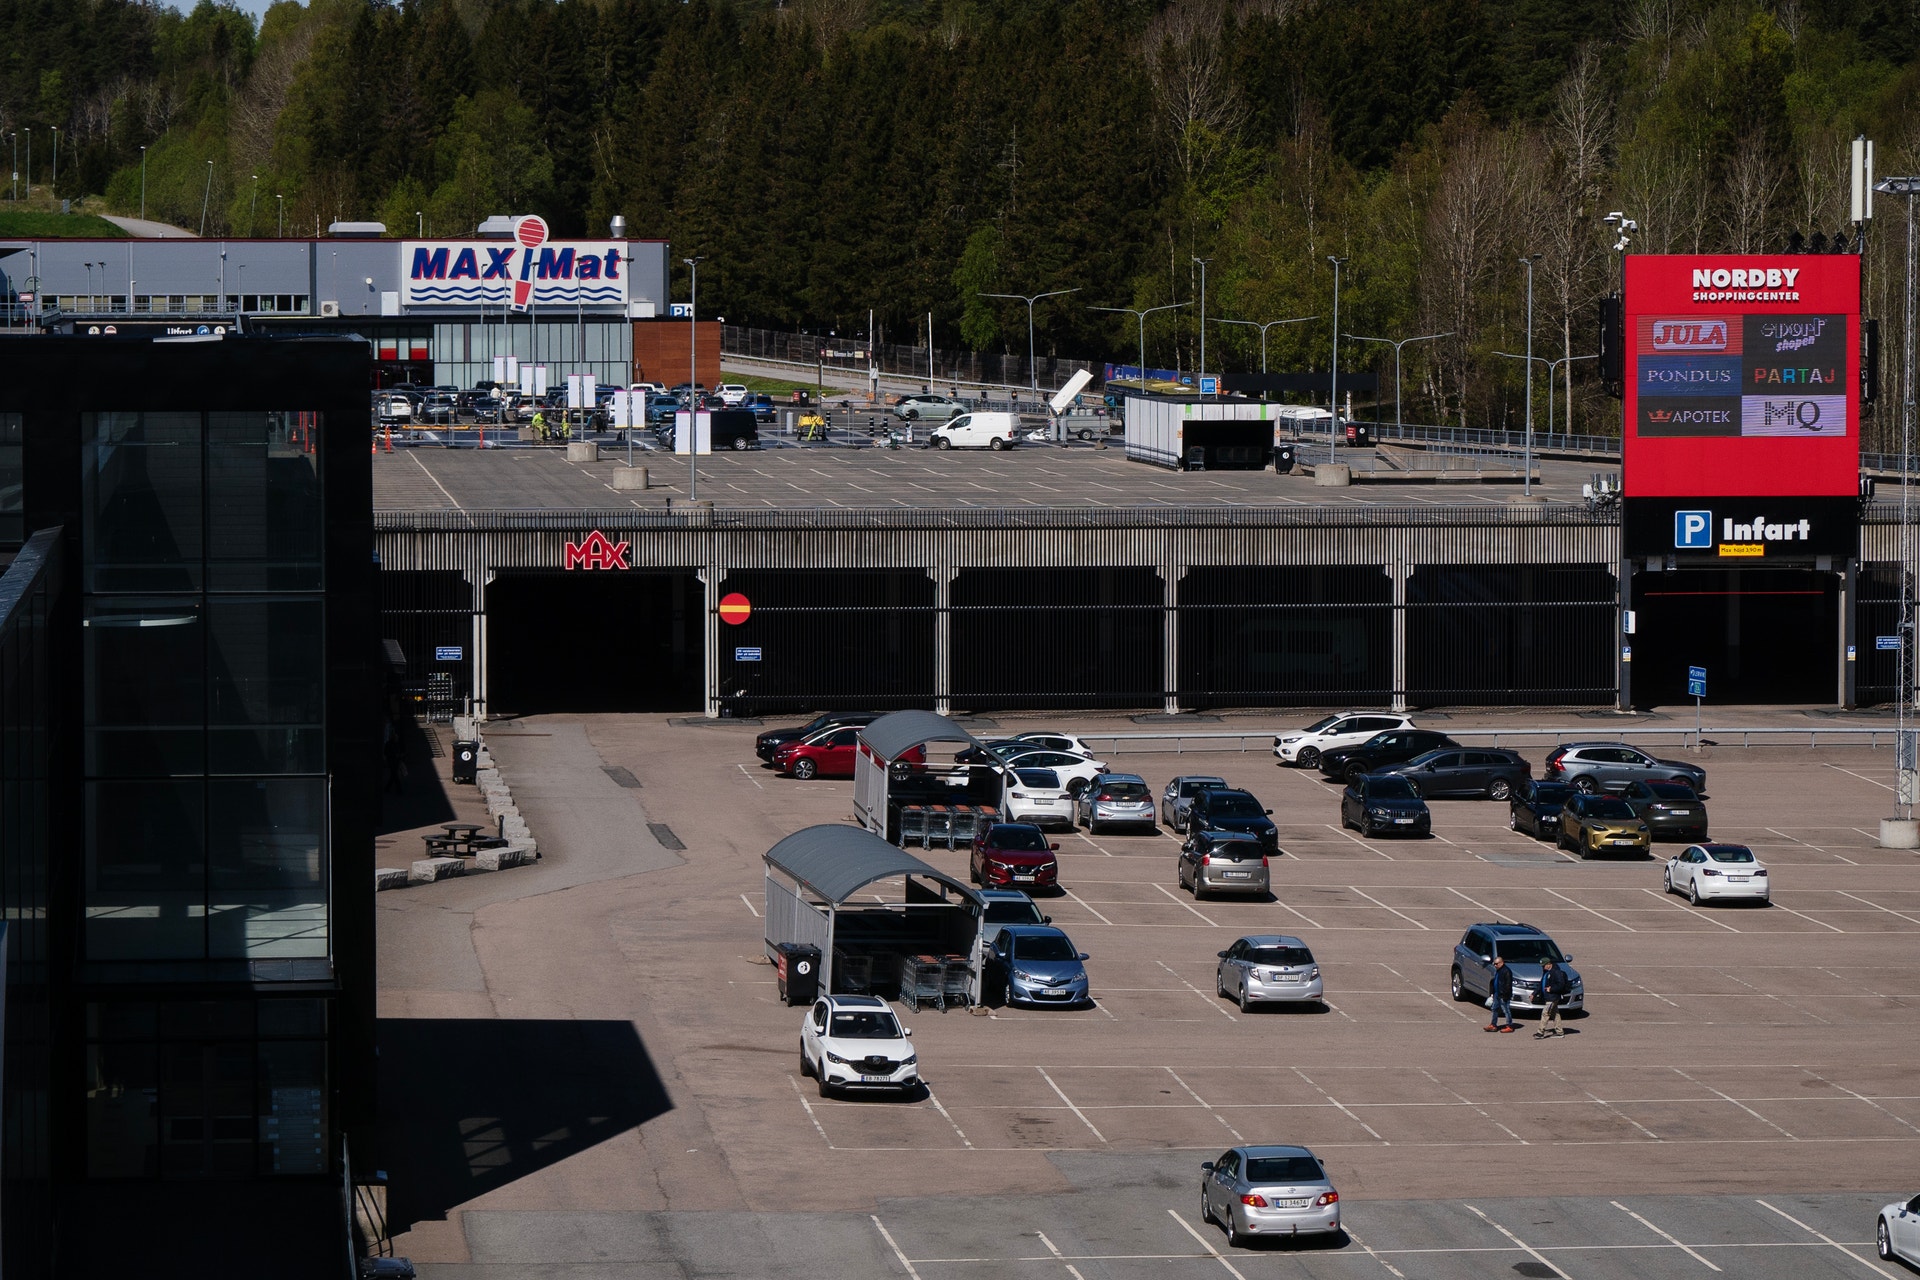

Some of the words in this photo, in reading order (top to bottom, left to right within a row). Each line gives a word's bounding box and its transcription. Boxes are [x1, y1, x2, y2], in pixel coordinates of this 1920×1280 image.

[1693, 268, 1799, 287] NORDBY
[1693, 292, 1799, 301] SHOPPINGCENTER
[674, 307, 684, 317] P
[1655, 325, 1725, 345] JULA
[1776, 336, 1815, 352] shopen
[1647, 369, 1731, 382] PONDUS
[1754, 368, 1835, 384] PARTAJ
[1672, 411, 1730, 423] APOTEK
[1765, 401, 1823, 431] MQ
[1685, 515, 1705, 543] P
[1723, 516, 1810, 540] Infart
[565, 530, 629, 570] MAX
